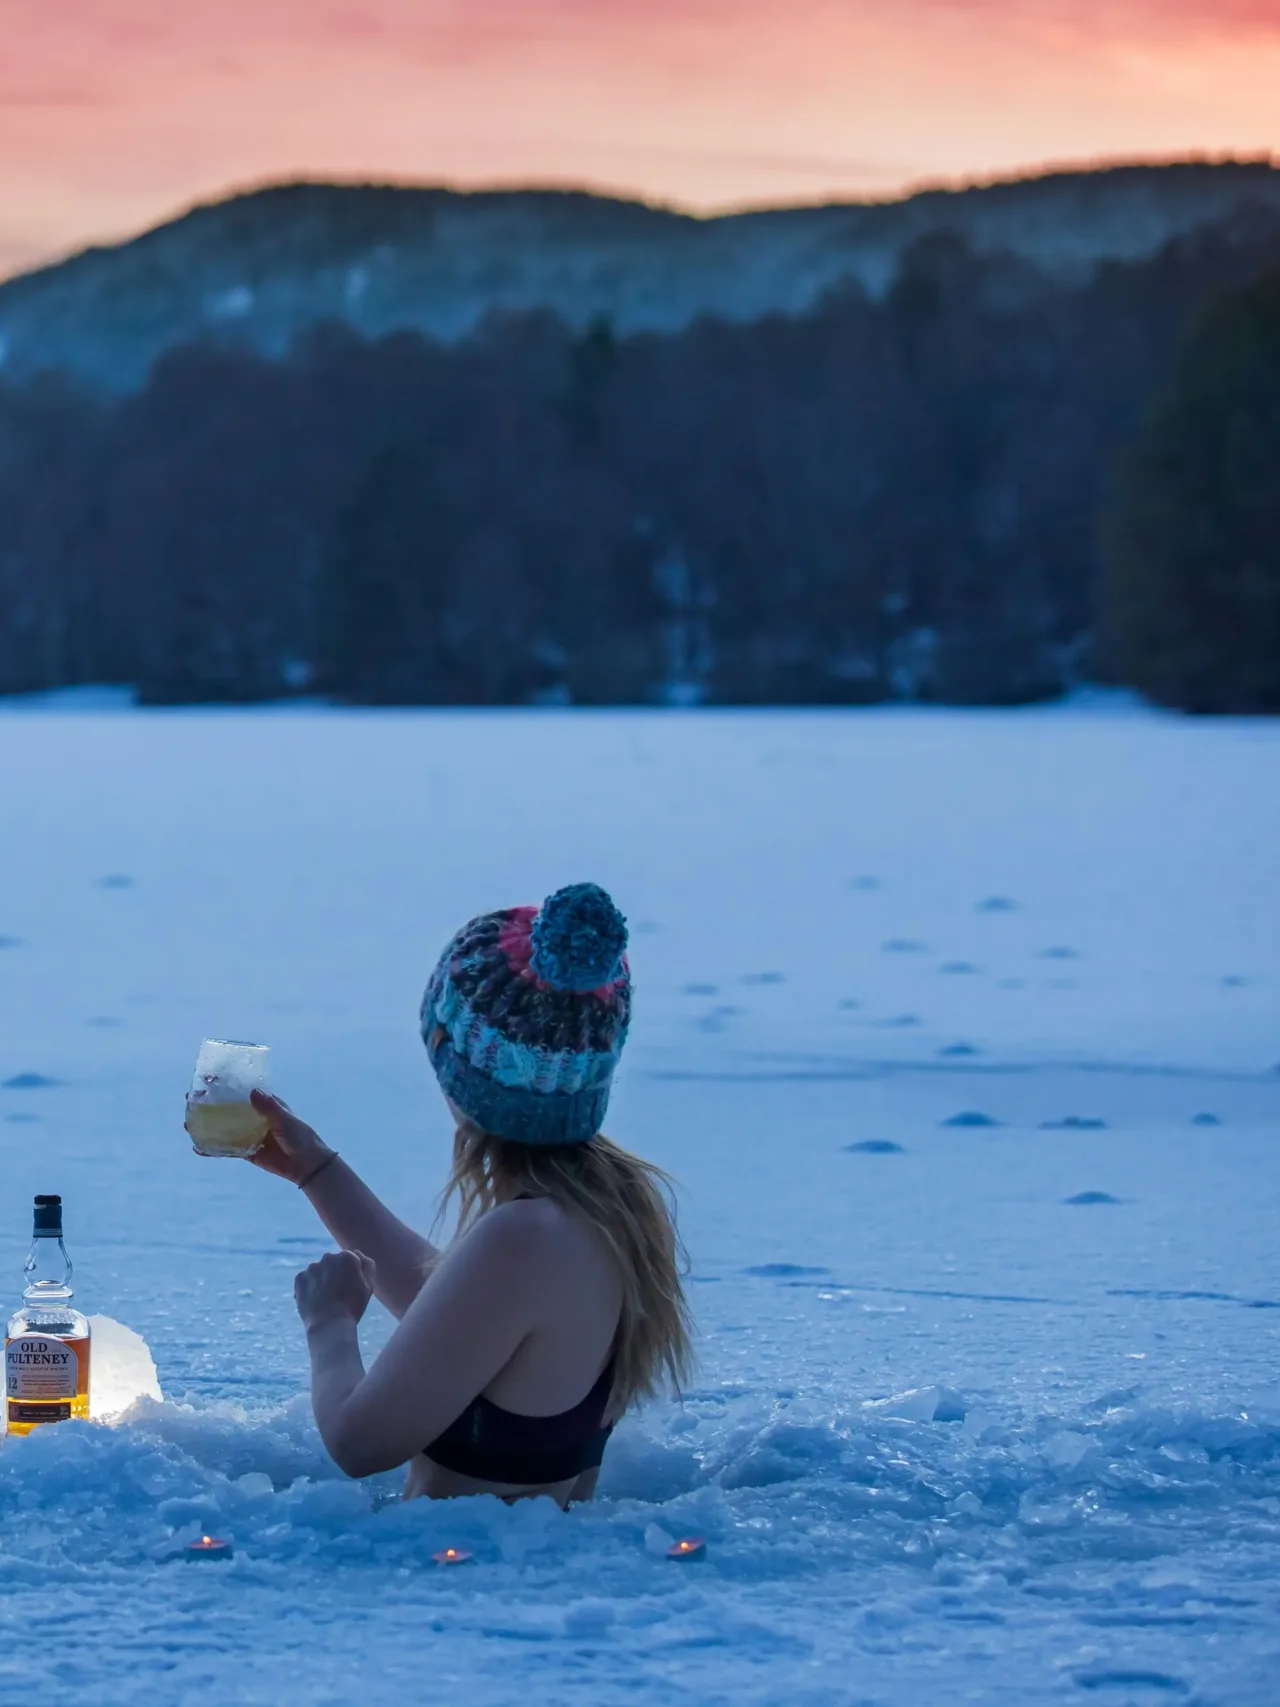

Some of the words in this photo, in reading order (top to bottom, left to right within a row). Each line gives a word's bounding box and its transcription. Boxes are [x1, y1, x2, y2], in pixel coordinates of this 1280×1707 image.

[21, 1342, 48, 1353] OLD
[7, 1353, 70, 1364] PULTENEY
[8, 1376, 18, 1390] 12
